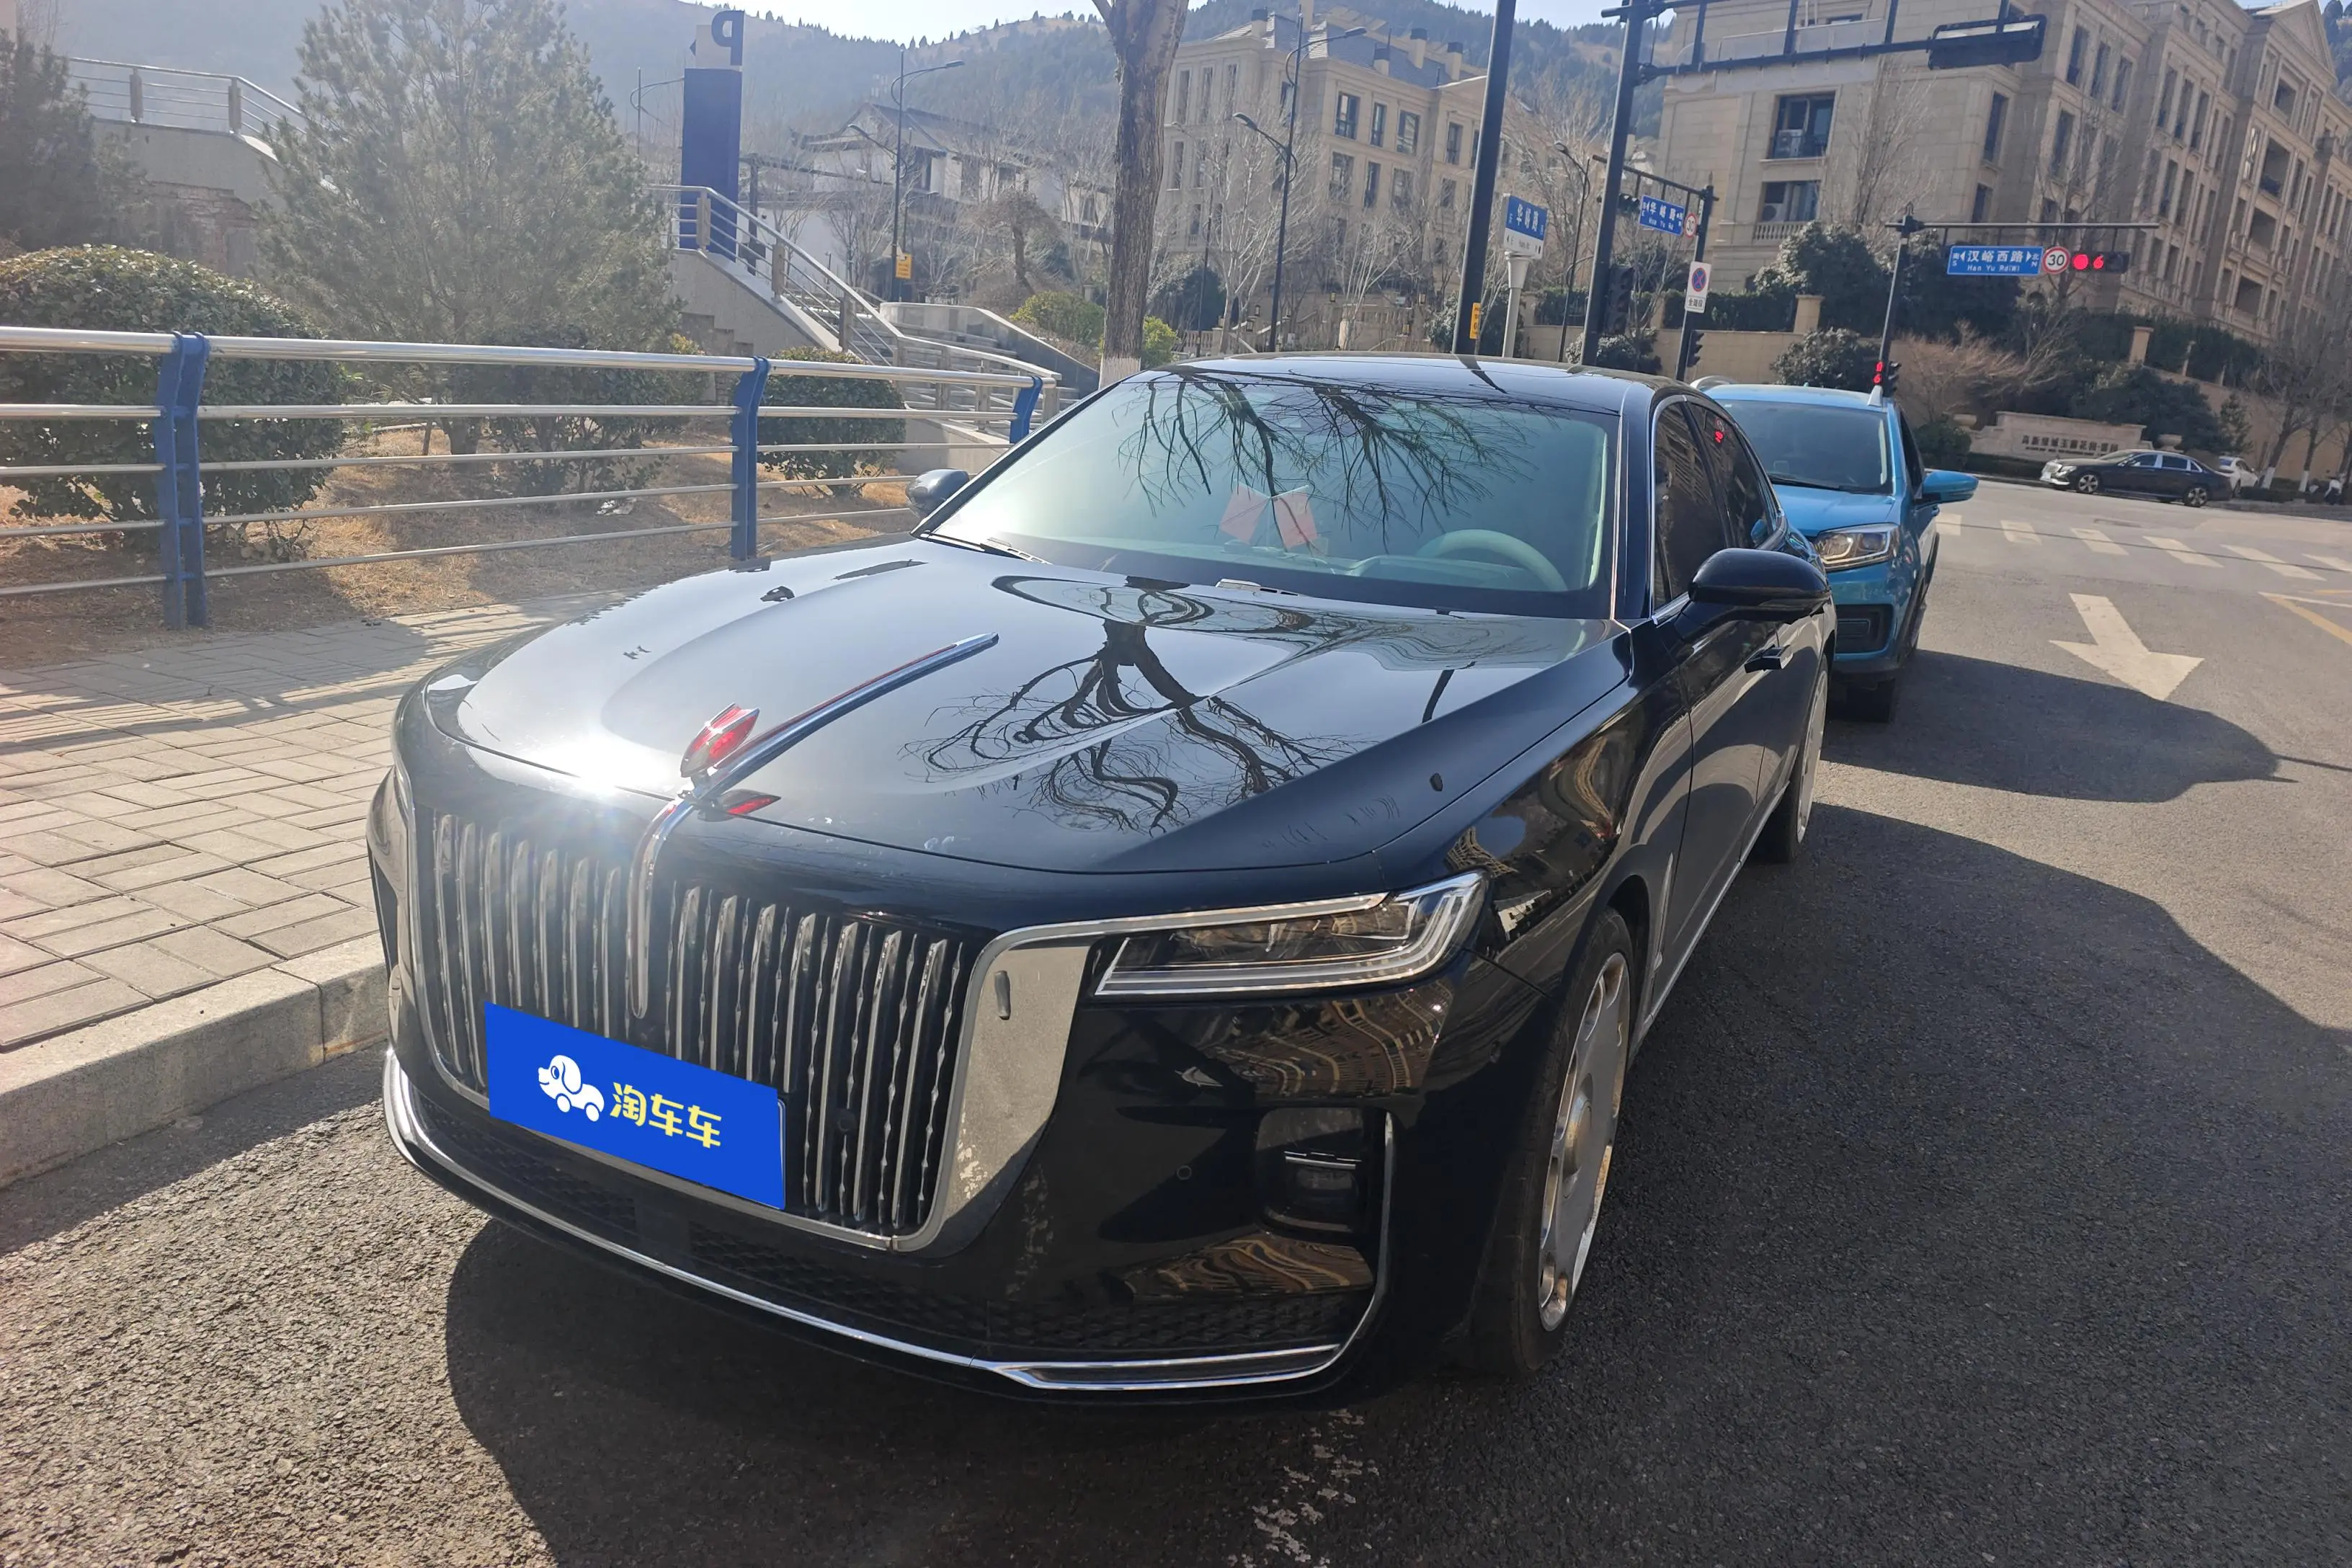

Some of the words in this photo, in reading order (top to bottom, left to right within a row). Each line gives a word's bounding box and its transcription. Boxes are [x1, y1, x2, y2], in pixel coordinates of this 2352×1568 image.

[1967, 250, 2024, 262] 汉峪西路
[2048, 254, 2065, 266] 30
